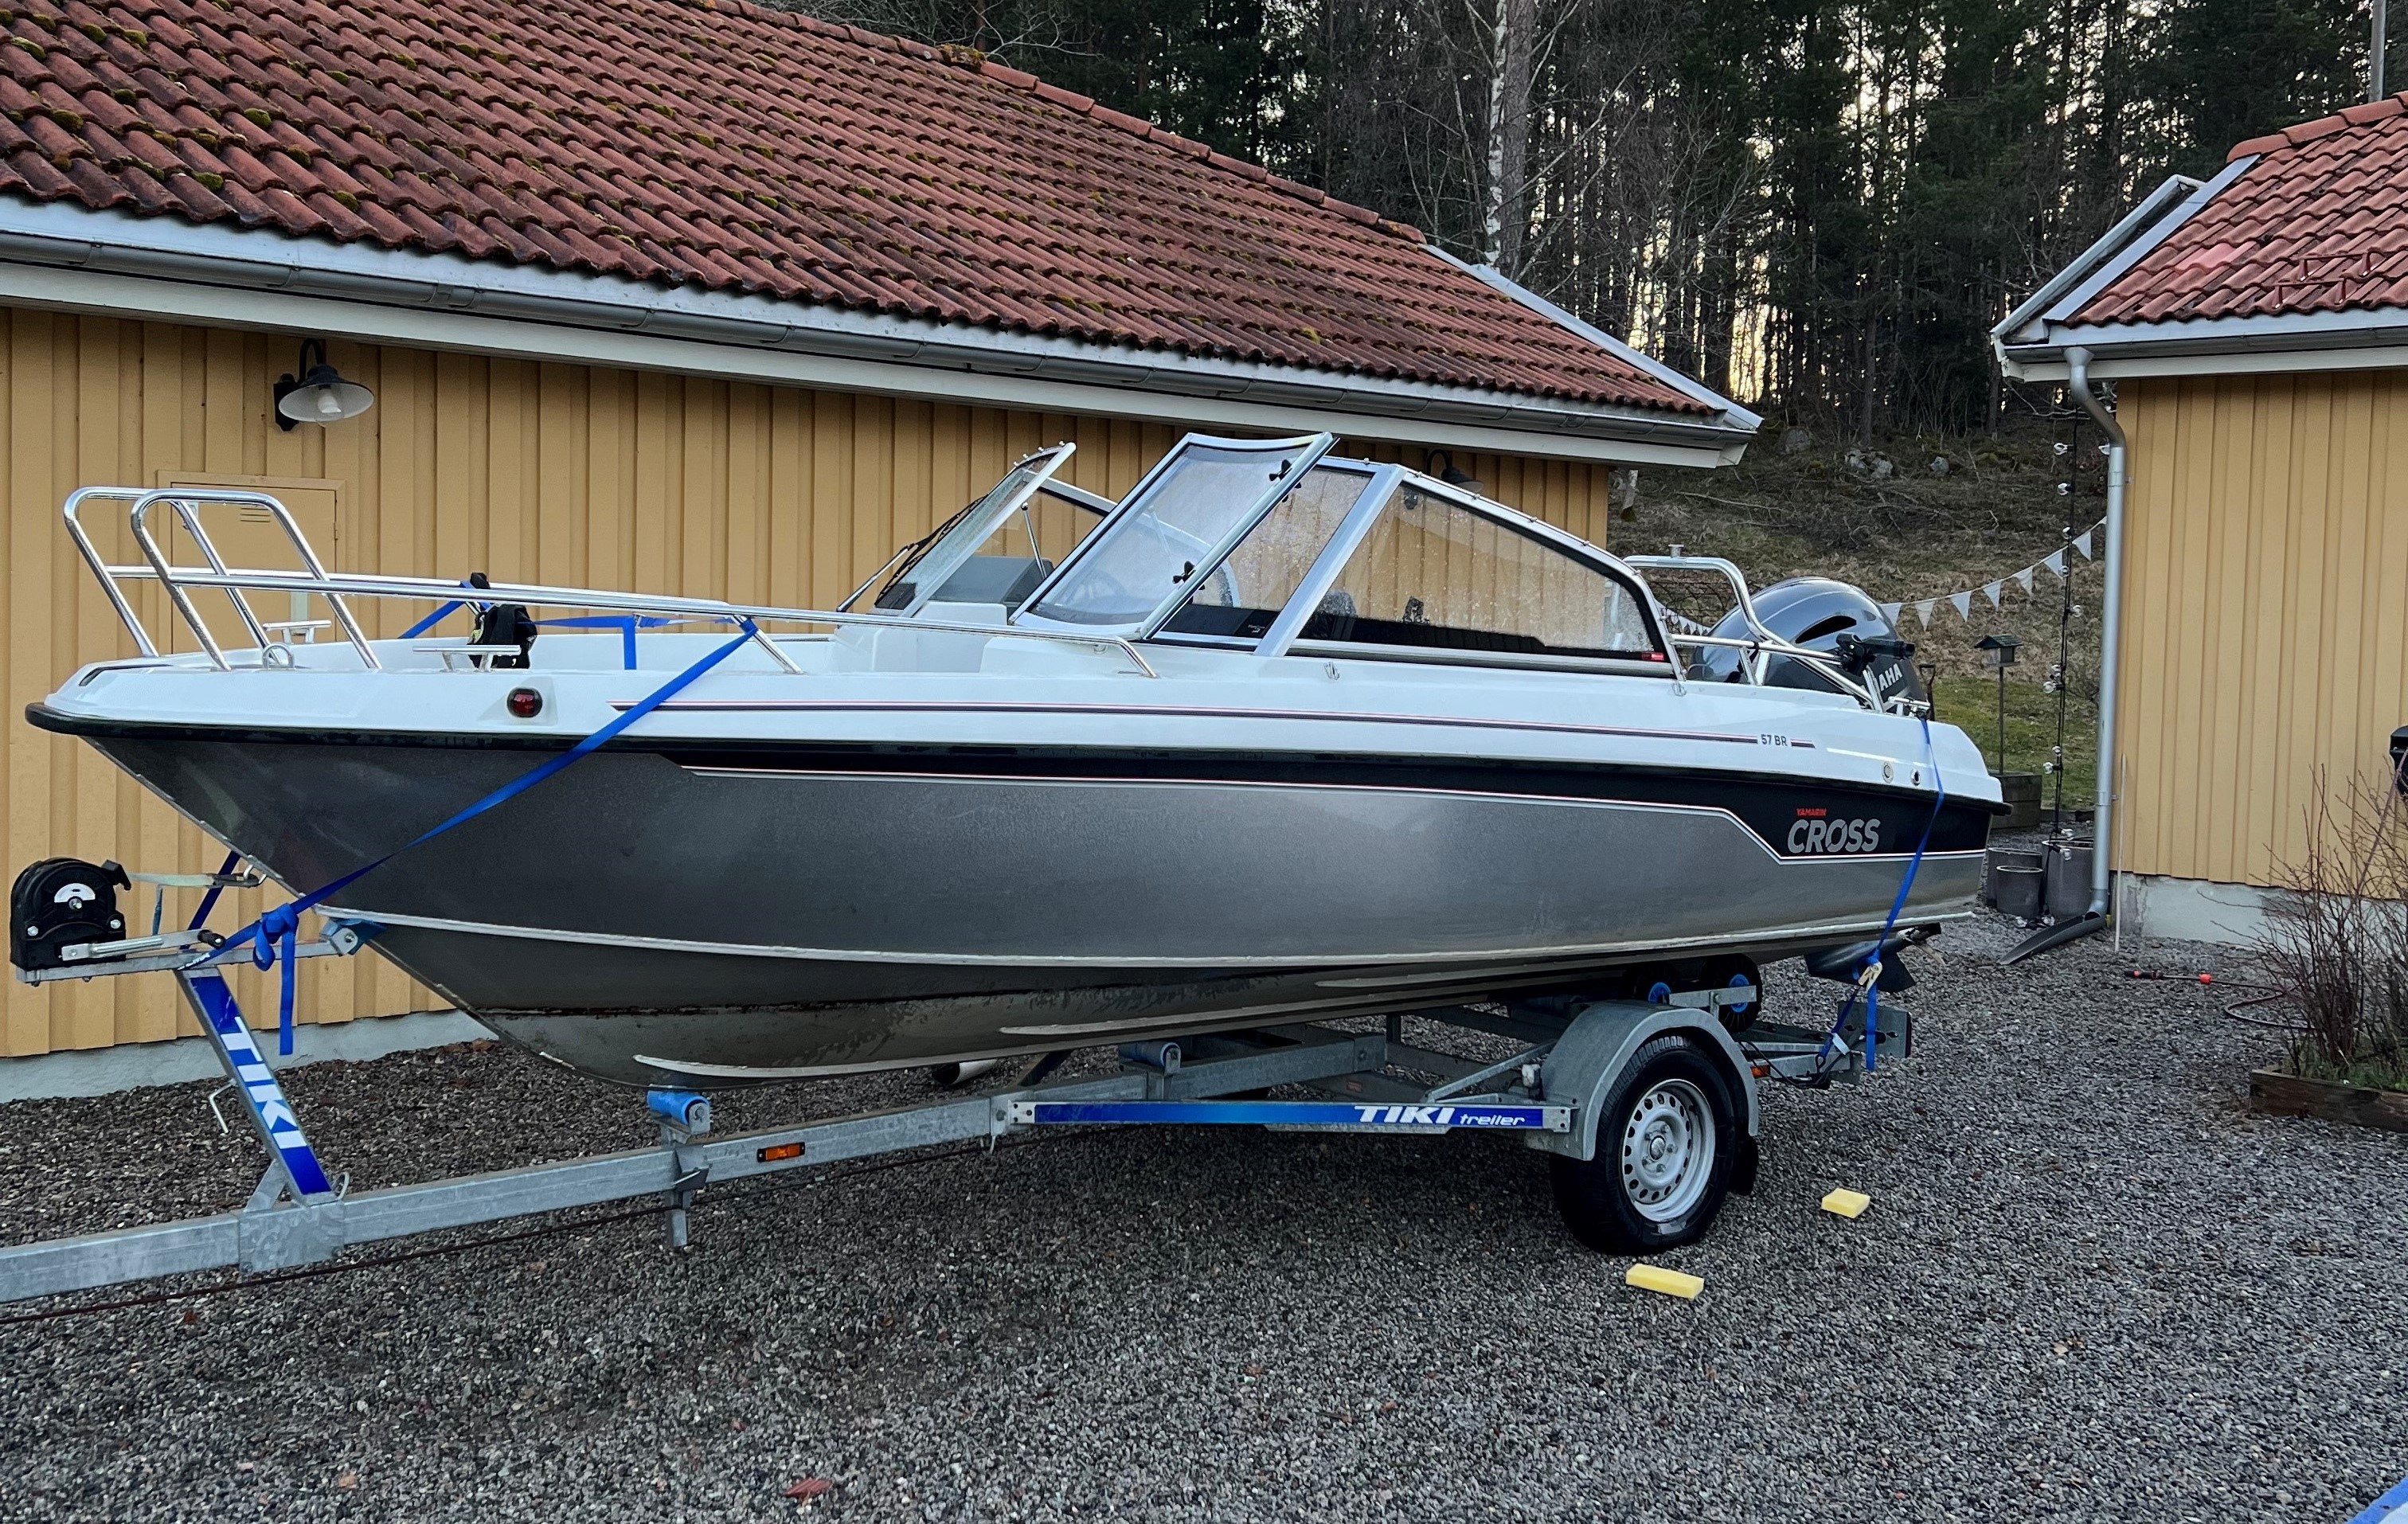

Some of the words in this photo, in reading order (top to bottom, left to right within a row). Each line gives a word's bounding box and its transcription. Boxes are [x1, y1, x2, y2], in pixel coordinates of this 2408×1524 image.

[1761, 733, 1772, 745] 57
[1774, 735, 1788, 746] BR
[1787, 819, 1881, 854] CROSS
[220, 1016, 307, 1149] TIKI
[1354, 1105, 1455, 1123] TIKI
